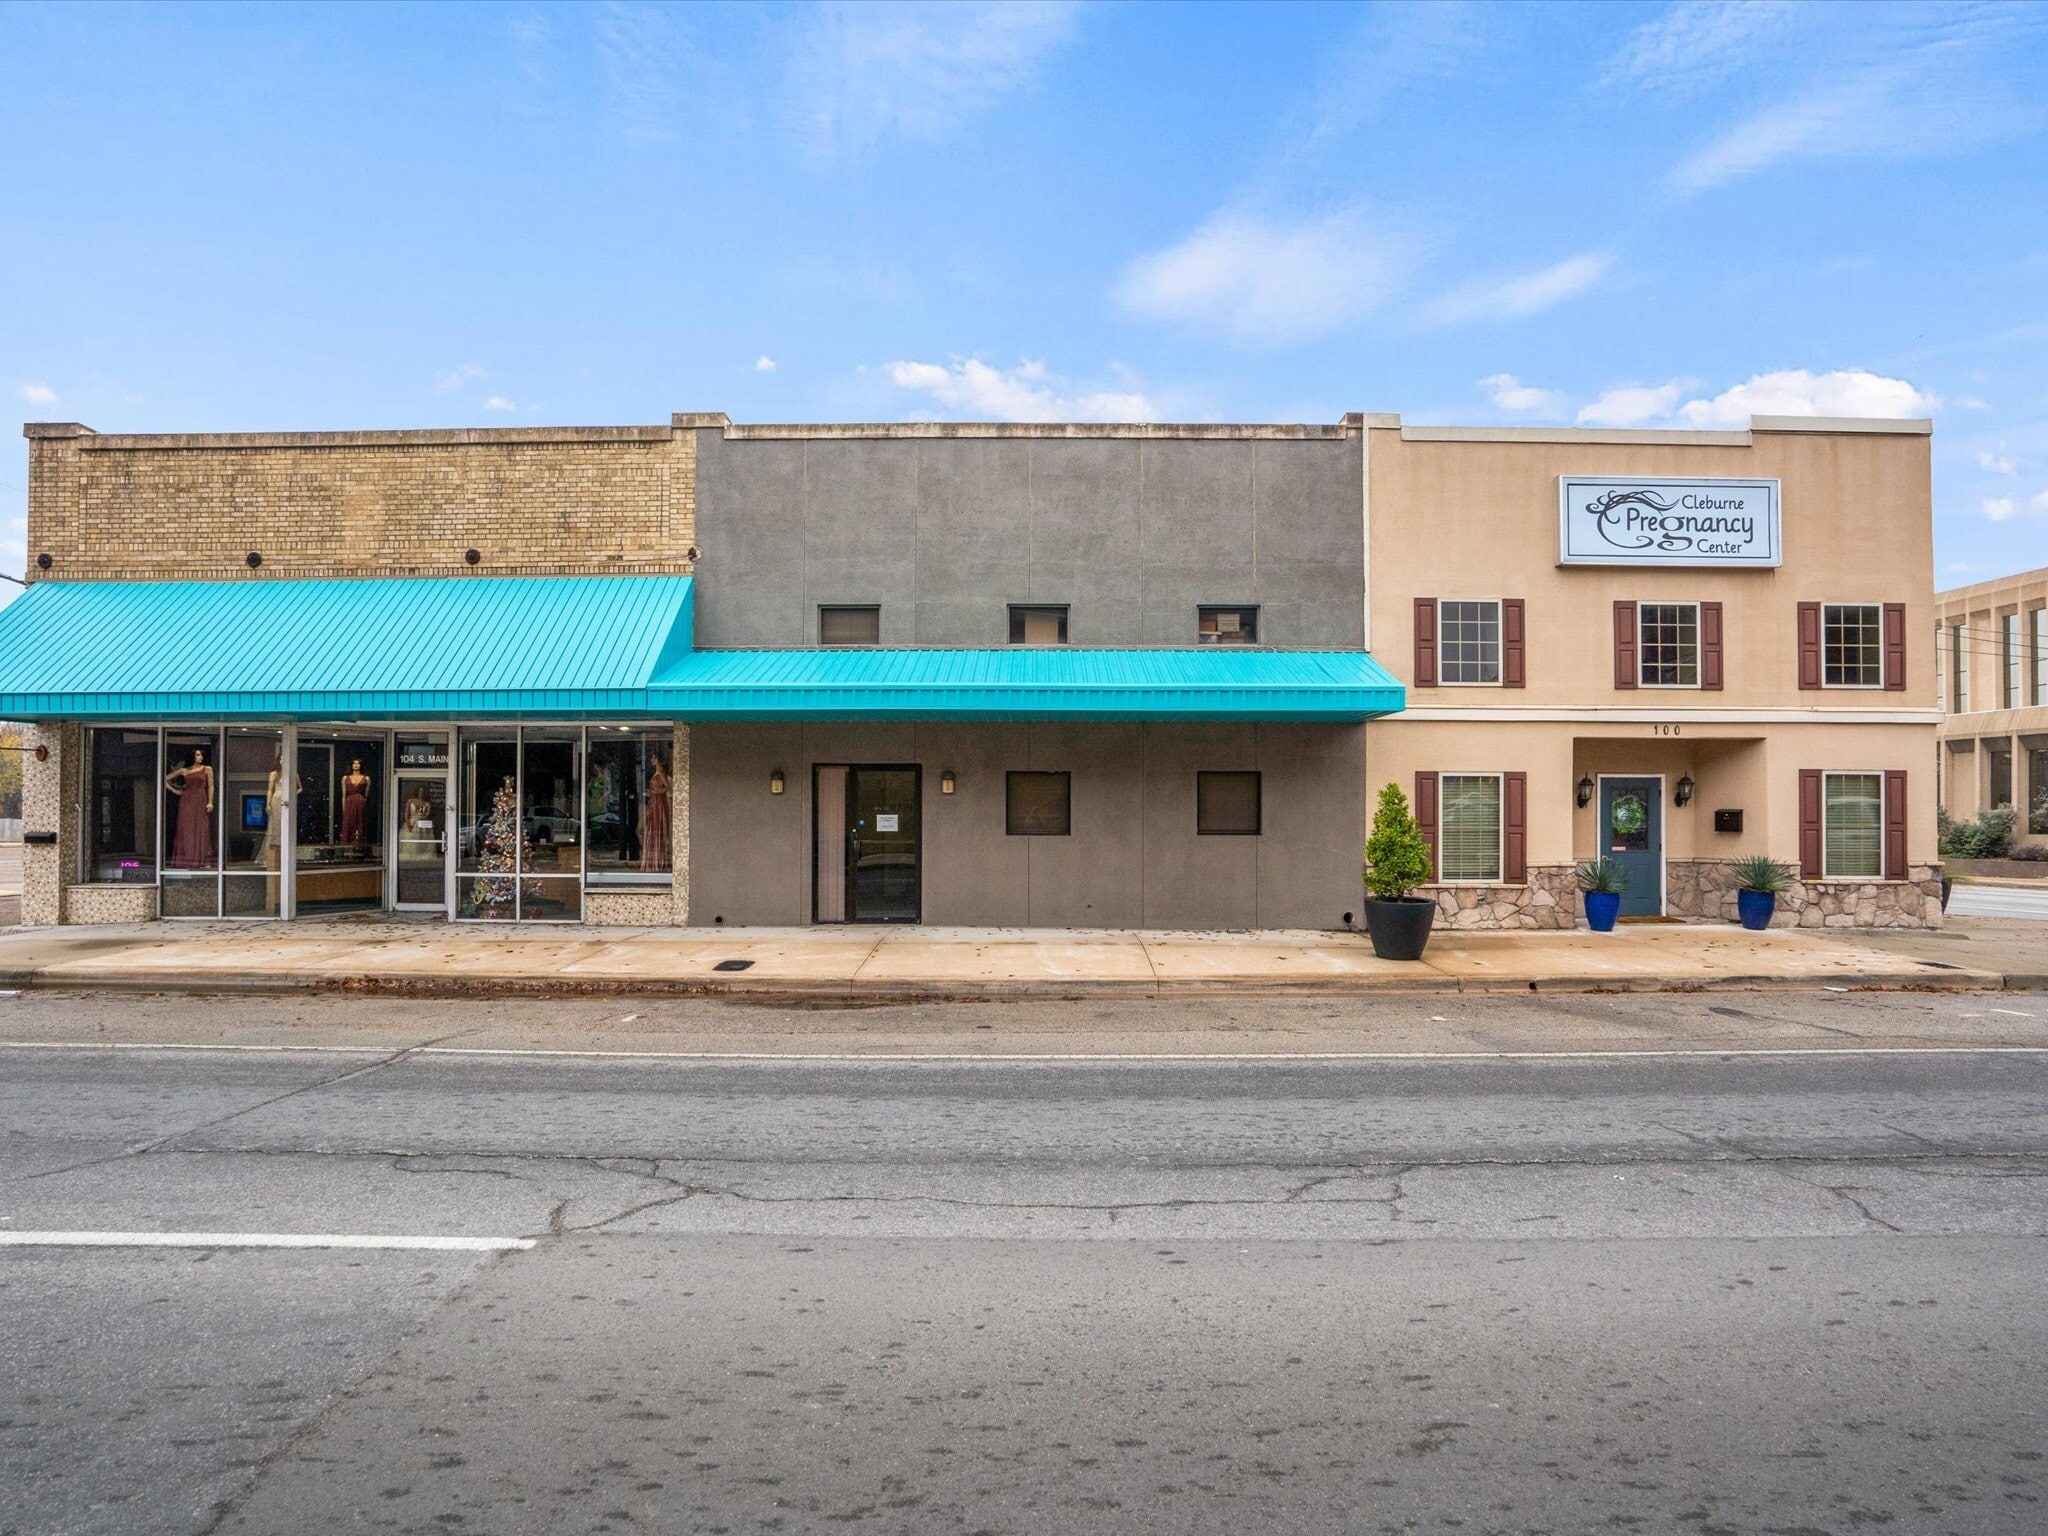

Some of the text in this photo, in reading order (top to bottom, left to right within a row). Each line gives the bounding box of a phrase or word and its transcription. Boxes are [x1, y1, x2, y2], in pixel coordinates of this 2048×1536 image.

[1681, 494, 1744, 510] Cleburne
[1626, 507, 1753, 551] Pregnancy
[1696, 539, 1743, 554] Center
[1653, 724, 1681, 736] 100
[400, 754, 449, 764] 104 S. MAIN
